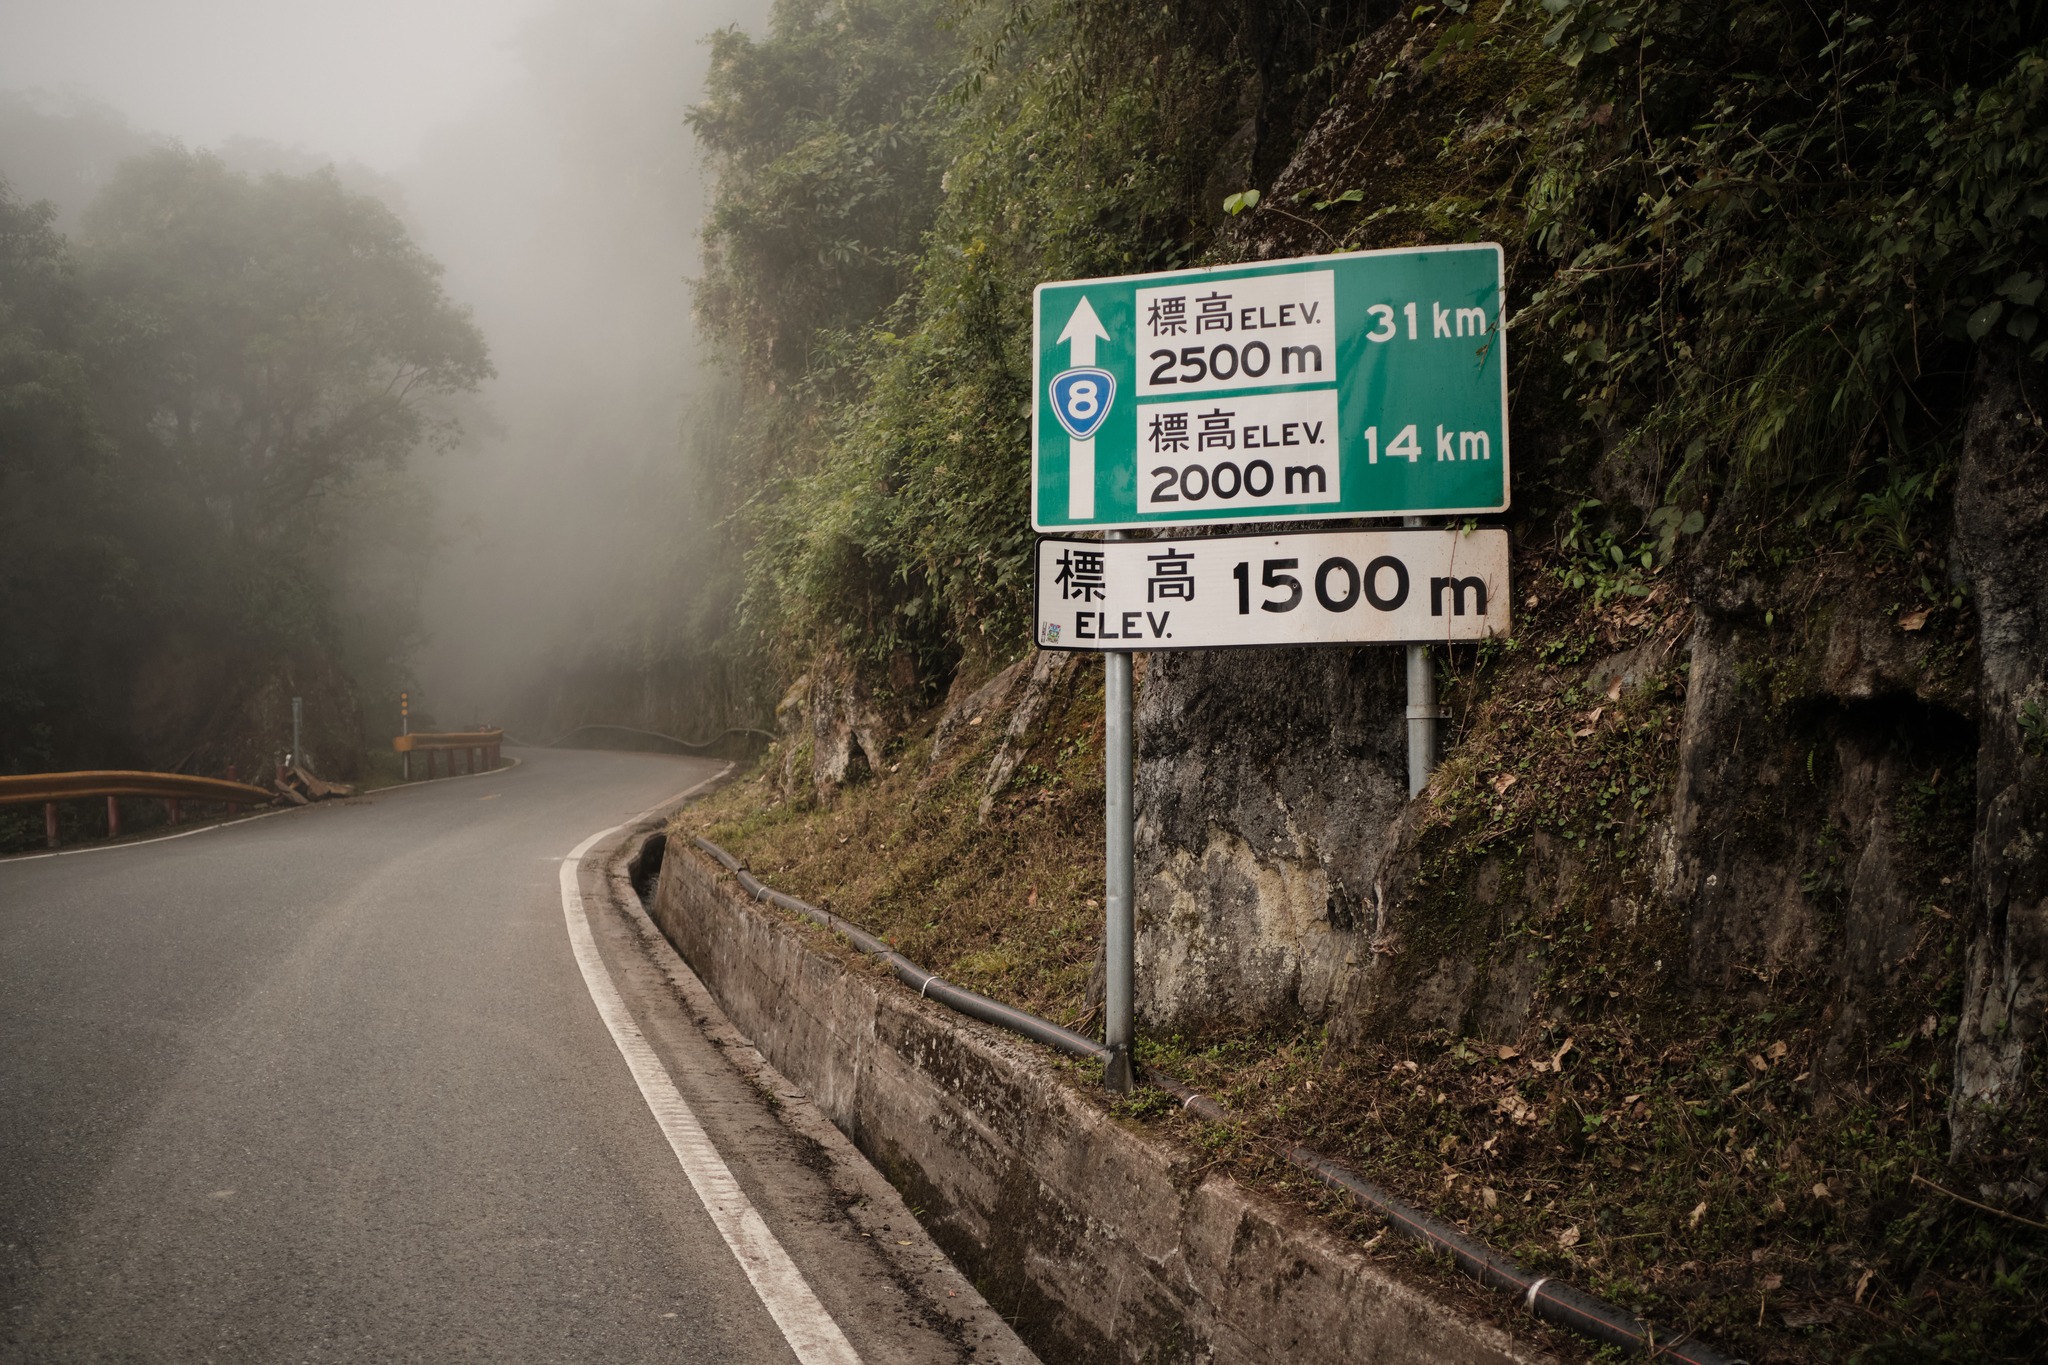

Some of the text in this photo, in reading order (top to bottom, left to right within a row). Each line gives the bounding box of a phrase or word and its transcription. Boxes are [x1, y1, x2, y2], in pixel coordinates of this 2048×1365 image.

[1147, 291, 1321, 337] 標高 ELEV.
[1365, 301, 1487, 343] 31 km
[1149, 340, 1322, 386] 2500 m
[1067, 380, 1098, 420] 8
[1148, 408, 1325, 453] 標高 ELEV.
[1364, 423, 1490, 465] 14 km
[1150, 459, 1327, 503] 2000 m
[1233, 555, 1410, 615] 1500
[1430, 576, 1488, 617] m
[1075, 611, 1173, 639] ELEV.
